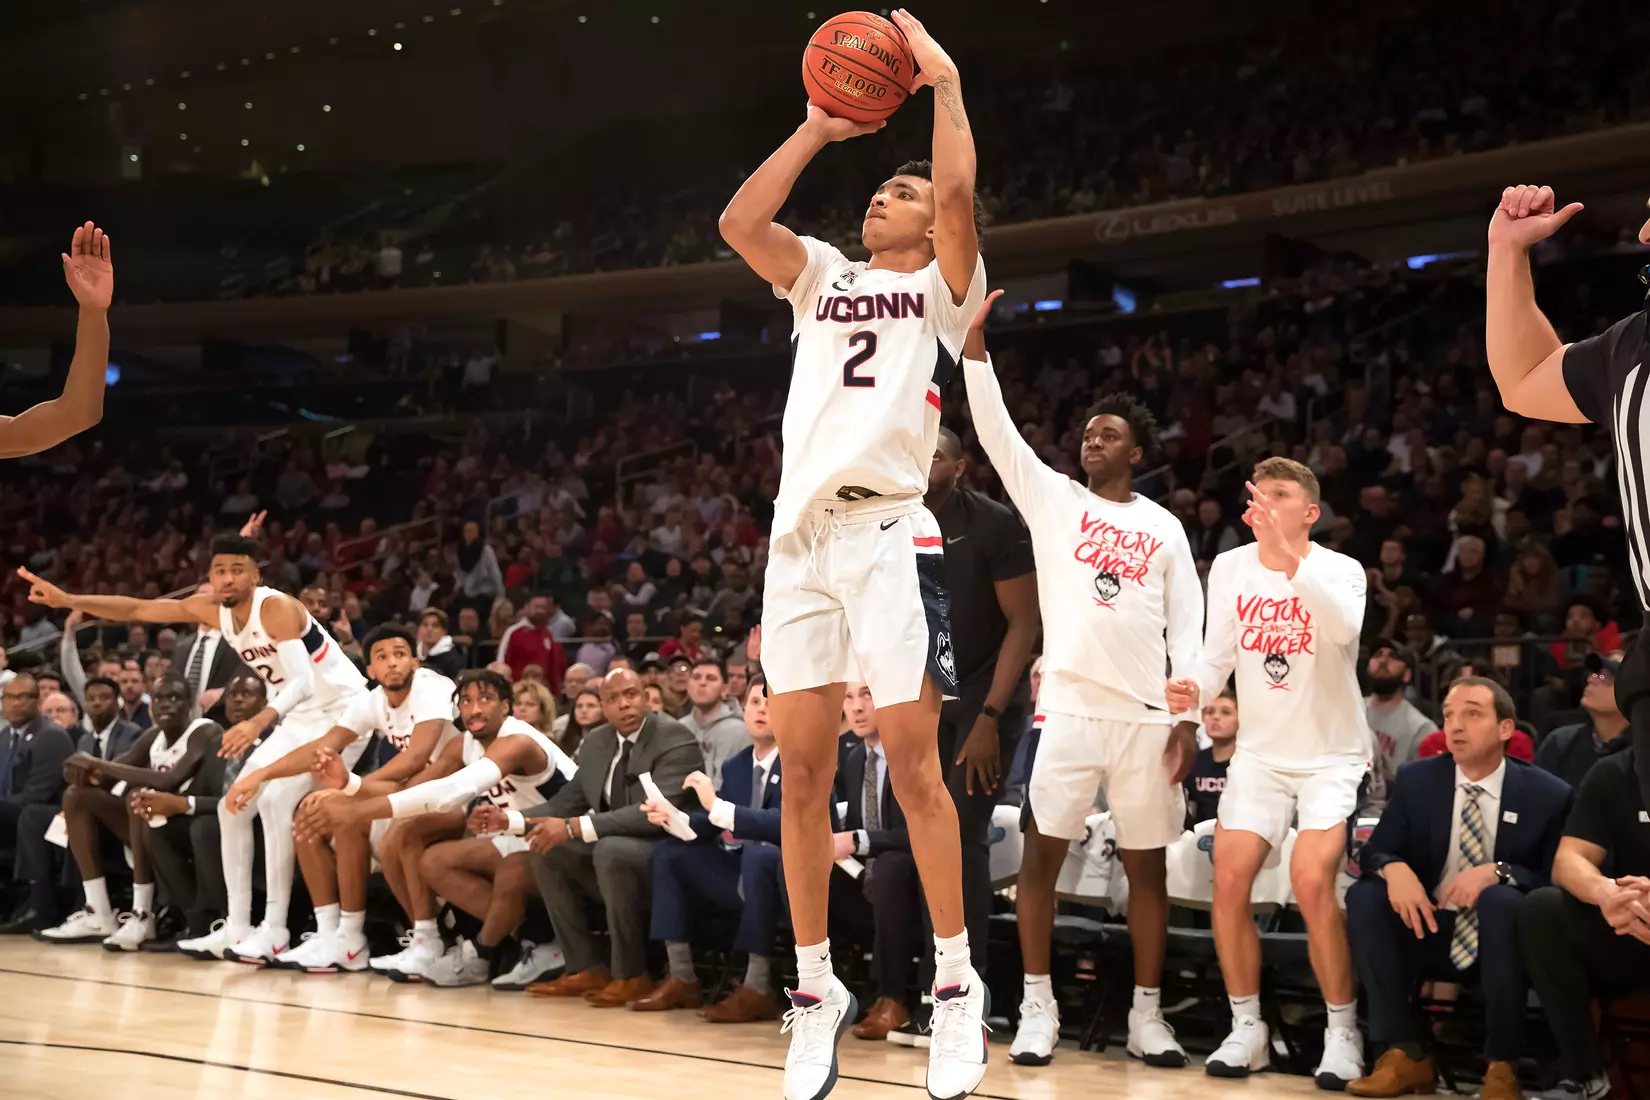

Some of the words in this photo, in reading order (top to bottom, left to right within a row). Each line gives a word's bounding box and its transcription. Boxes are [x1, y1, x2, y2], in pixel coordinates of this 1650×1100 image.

[830, 30, 902, 76] SPALDING
[1134, 206, 1238, 235] LEXUS
[1272, 190, 1328, 216] SUITE
[1333, 182, 1395, 206] LEVEL
[816, 292, 925, 323] UCONN
[843, 330, 878, 388] 2
[1080, 511, 1164, 566] VICTORY
[1074, 541, 1148, 587] CANCER
[241, 643, 278, 662] ONN
[1241, 628, 1316, 655] CANCER
[256, 664, 285, 685] 2
[1195, 776, 1228, 792] UCO
